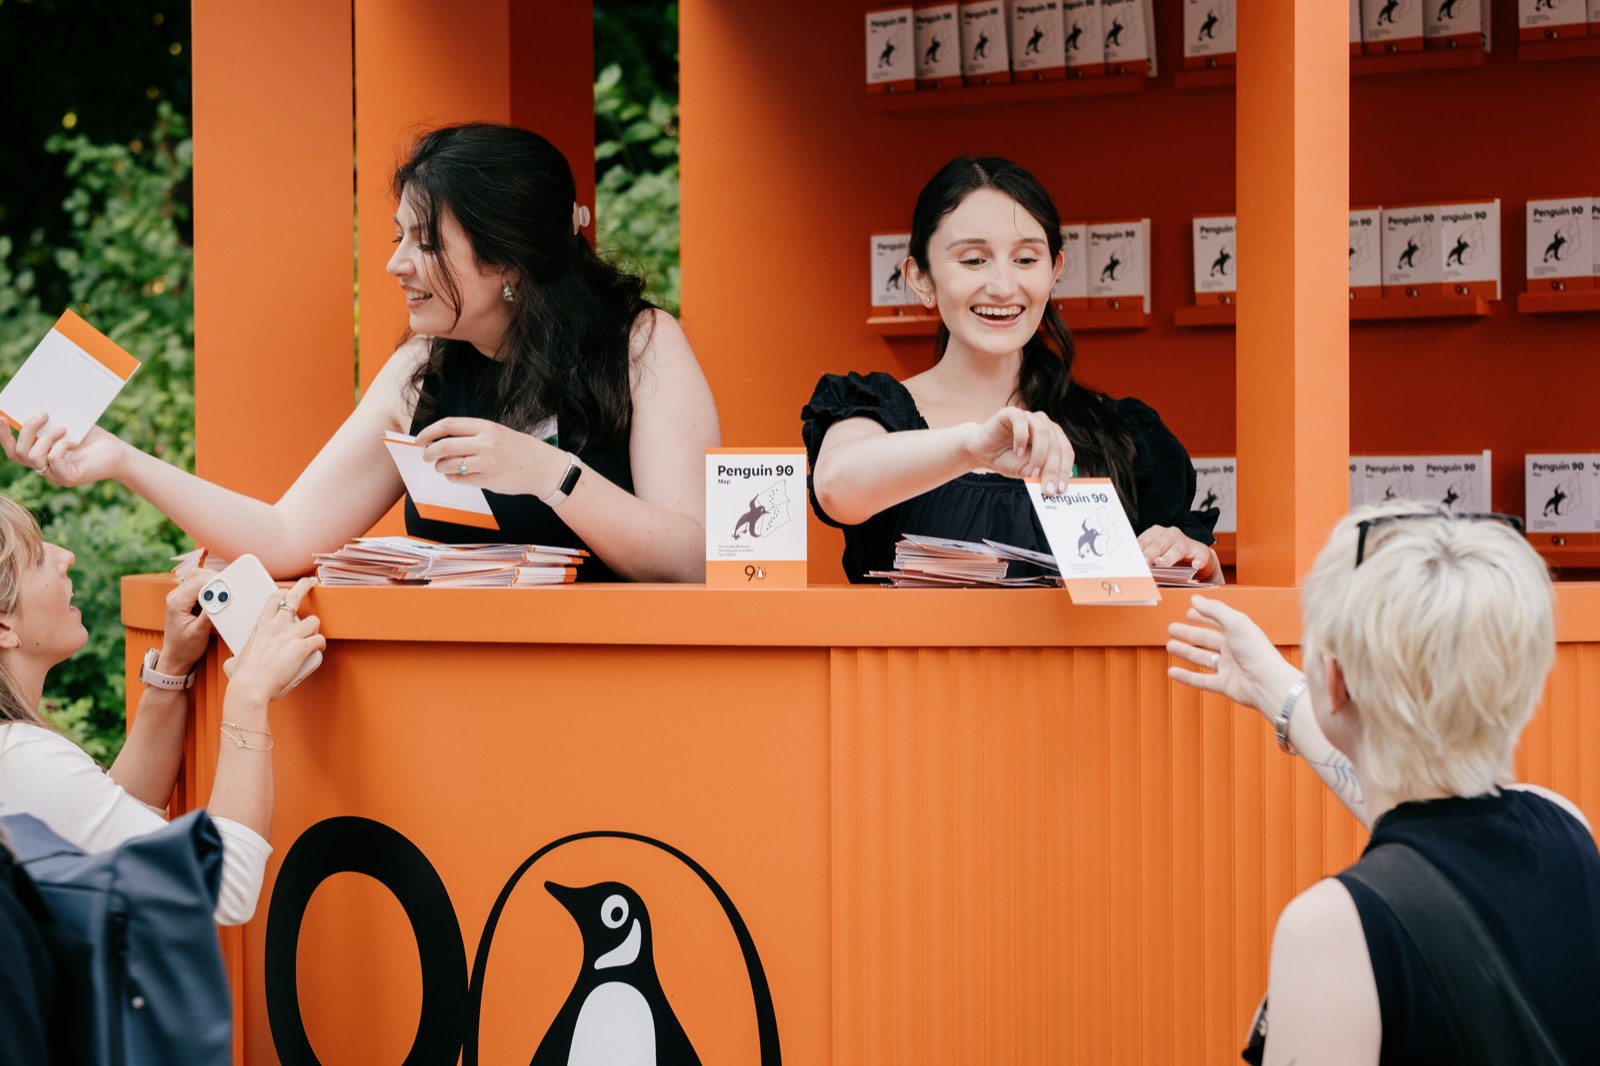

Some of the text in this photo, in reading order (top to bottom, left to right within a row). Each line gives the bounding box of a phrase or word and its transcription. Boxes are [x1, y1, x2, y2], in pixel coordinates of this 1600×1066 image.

[1441, 211, 1473, 223] enguin
[1533, 206, 1570, 218] Penguin
[718, 464, 794, 479] Penguin 90
[1365, 462, 1401, 474] Penguin
[1426, 462, 1462, 474] Penguin
[1533, 462, 1570, 472] Penguin
[1571, 462, 1584, 470] 90
[1041, 492, 1108, 506] Penguin 90
